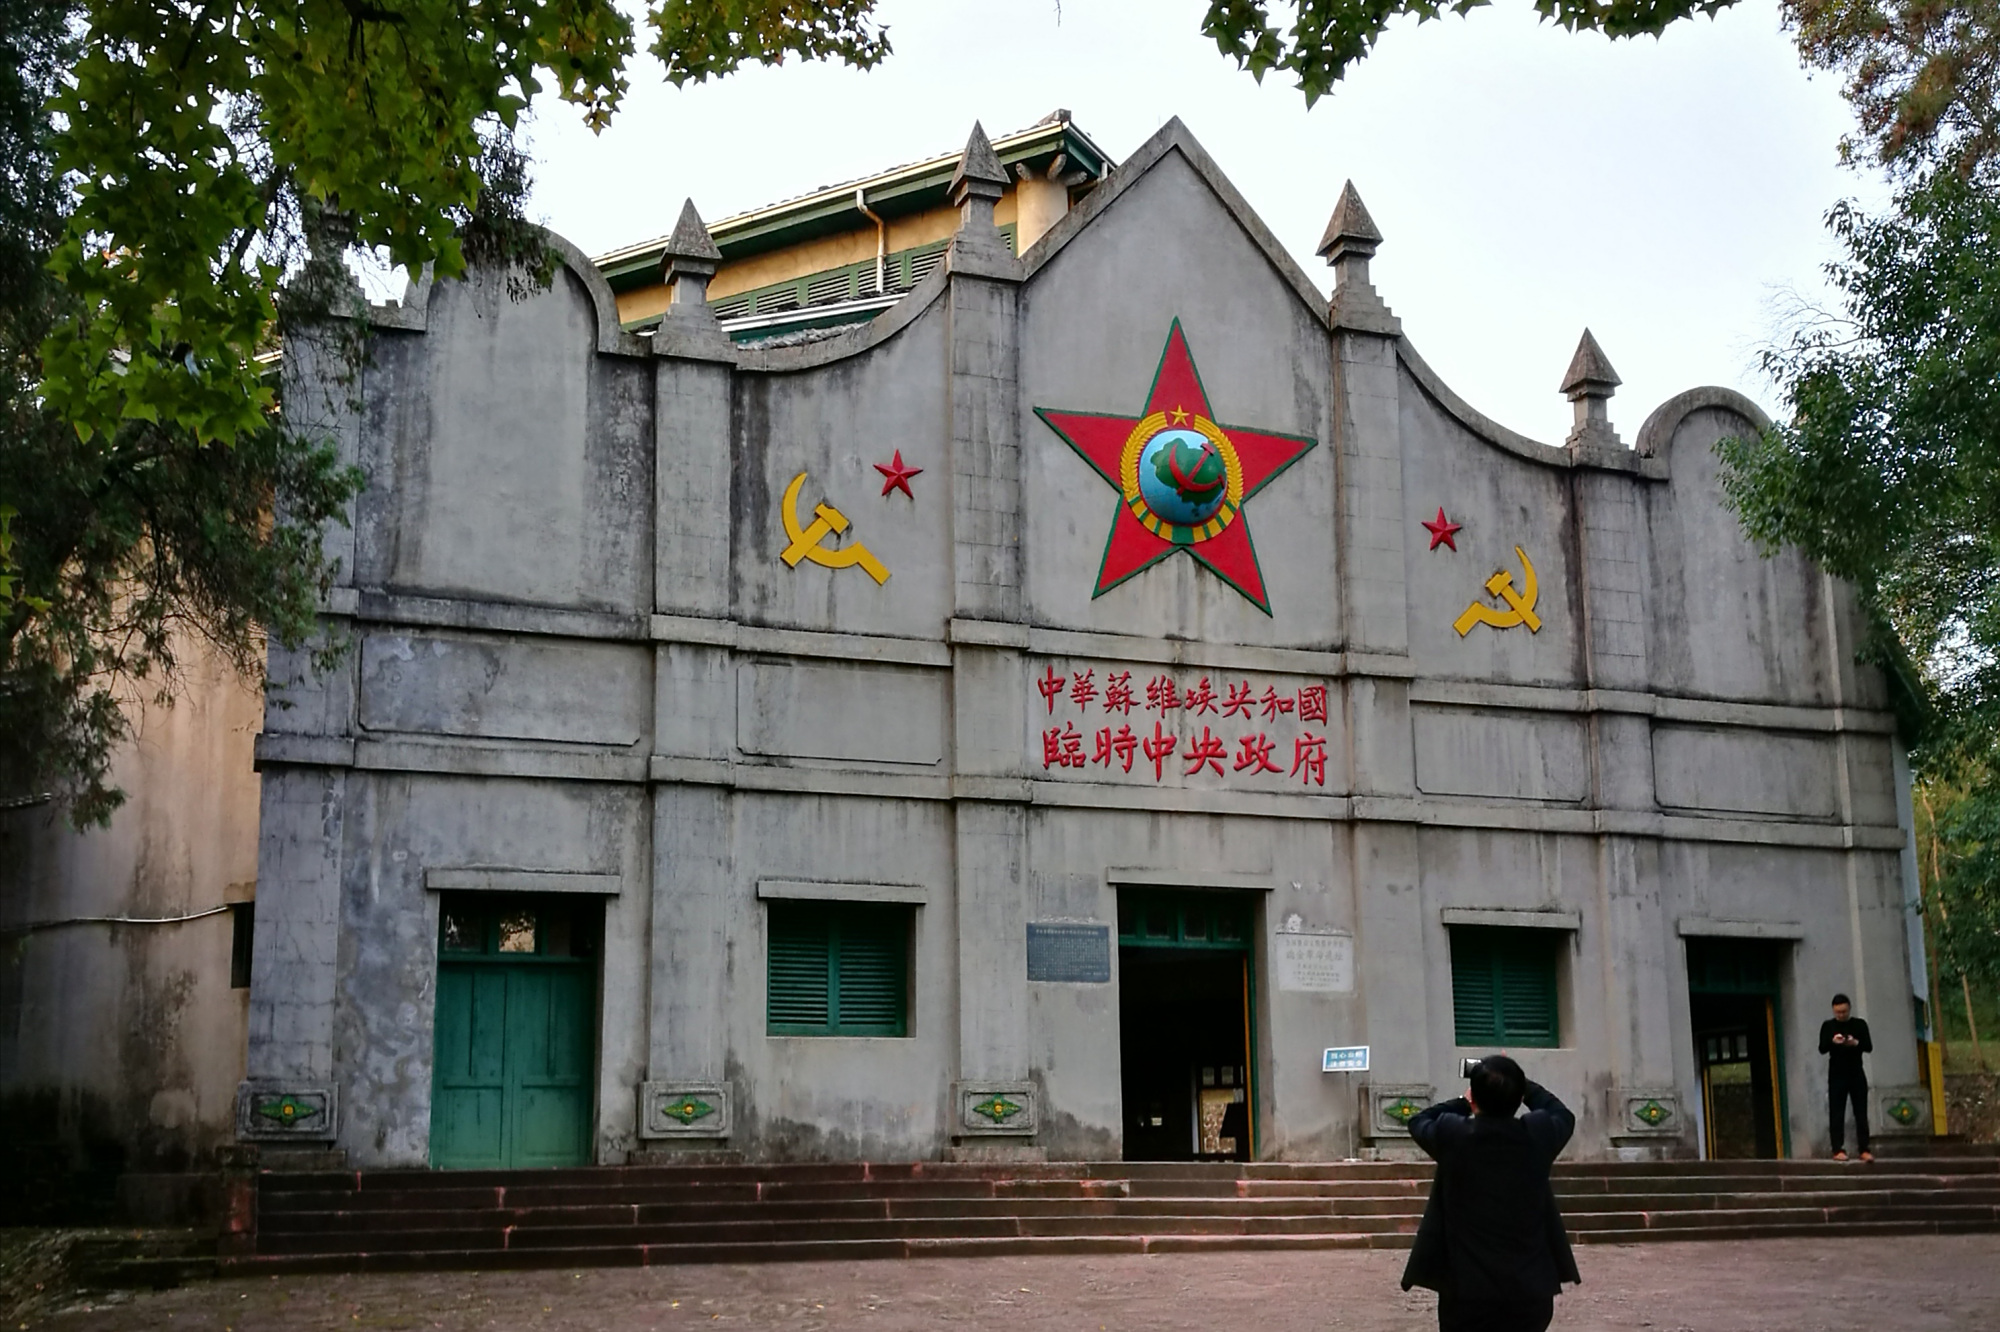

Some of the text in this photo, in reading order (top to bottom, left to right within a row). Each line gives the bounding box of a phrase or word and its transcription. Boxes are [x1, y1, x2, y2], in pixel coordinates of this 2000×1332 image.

[1037, 664, 1328, 726] 中華蘇維埃共和國
[1042, 720, 1328, 786] 臨時中央政府
